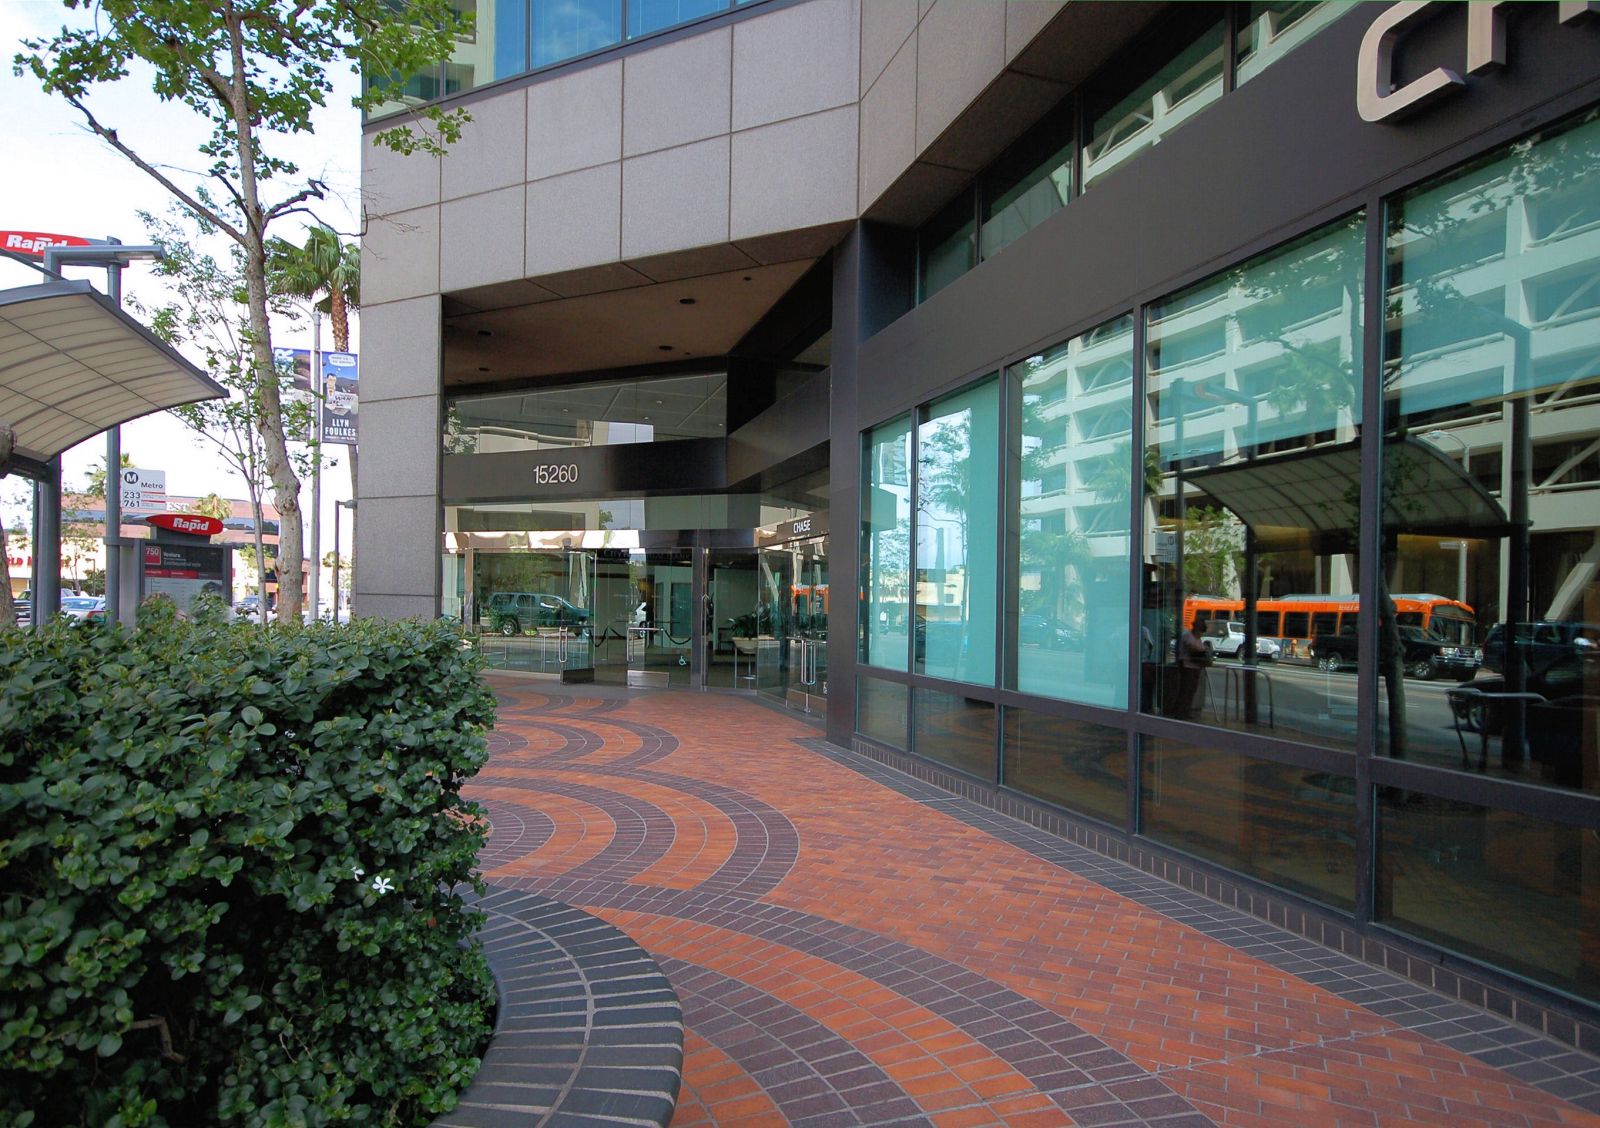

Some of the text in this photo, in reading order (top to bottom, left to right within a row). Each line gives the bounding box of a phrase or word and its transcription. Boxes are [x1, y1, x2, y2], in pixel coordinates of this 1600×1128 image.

[332, 418, 349, 427] LLYN
[325, 427, 356, 436] FOULKES
[533, 464, 578, 484] 15260
[124, 491, 141, 499] 233
[172, 517, 209, 531] Rapid
[793, 520, 811, 533] CHASE
[145, 547, 159, 556] 750
